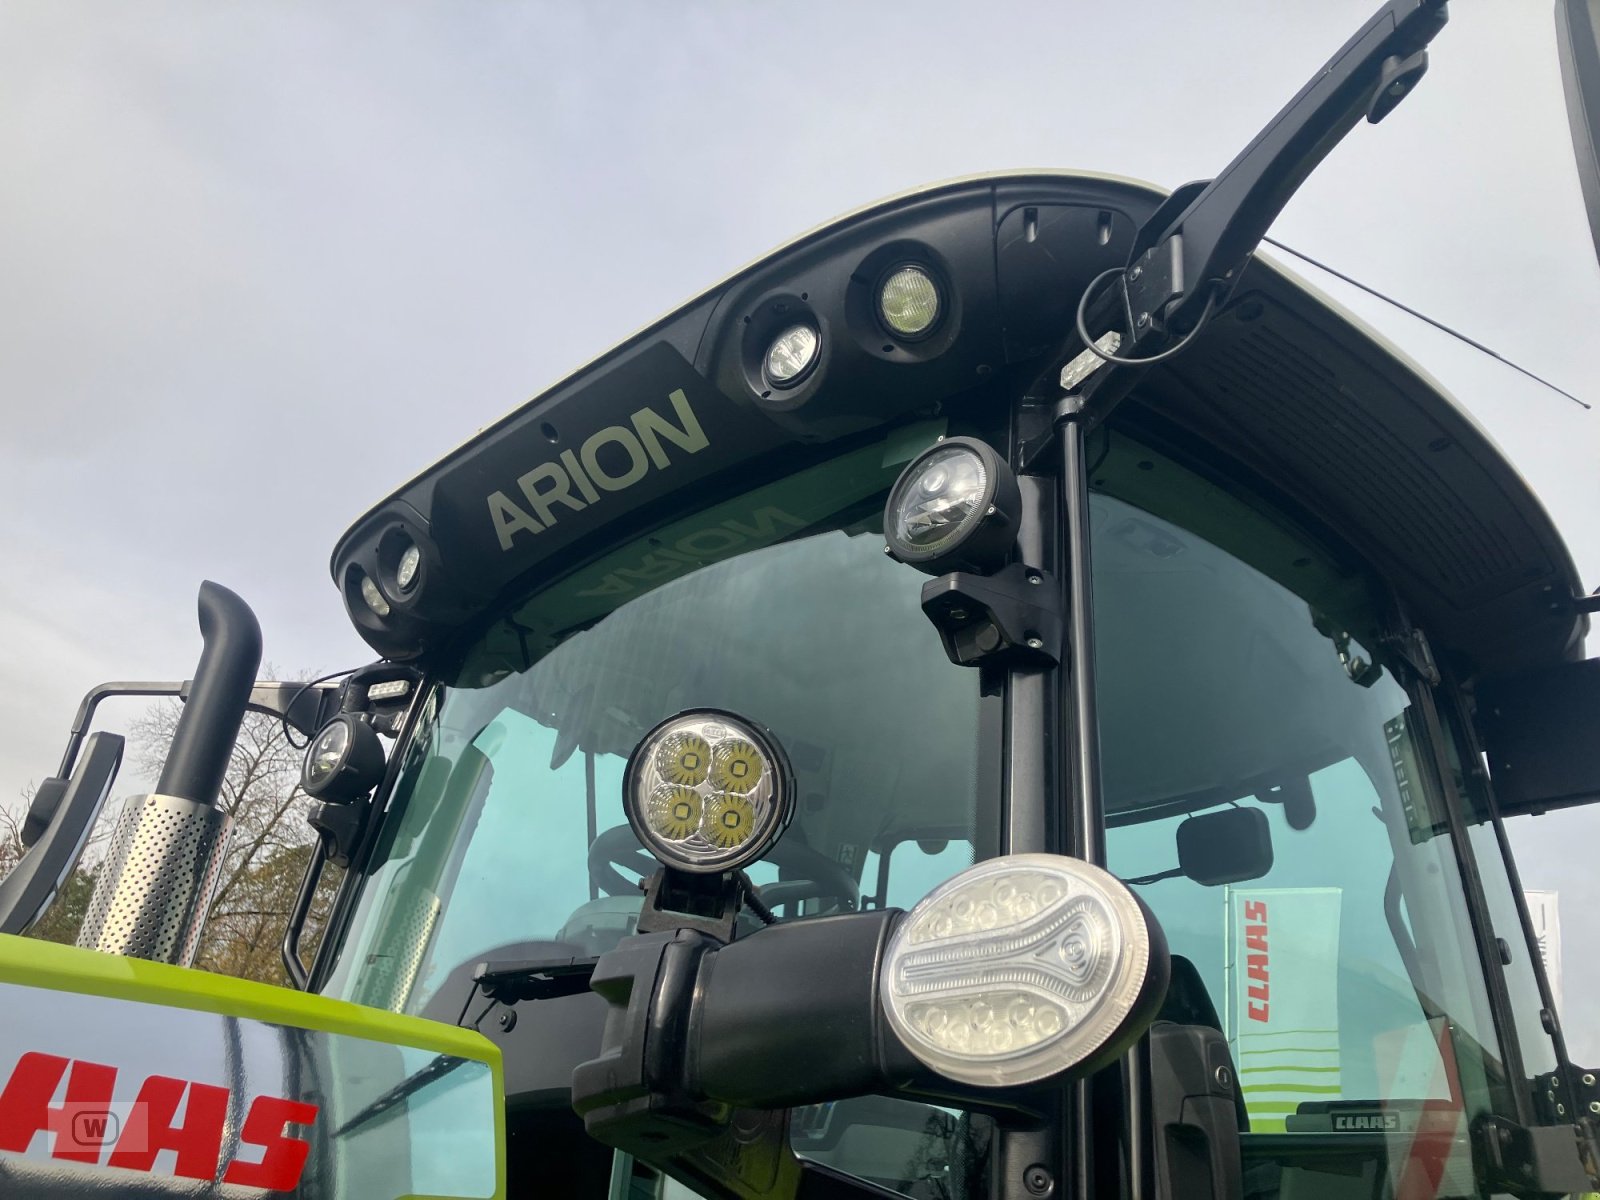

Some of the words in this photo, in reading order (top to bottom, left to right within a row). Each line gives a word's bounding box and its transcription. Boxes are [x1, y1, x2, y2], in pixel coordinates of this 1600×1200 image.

[487, 388, 710, 551] ARION
[1245, 900, 1269, 1022] CLAAS
[0, 1051, 319, 1193] AAS
[1336, 1116, 1396, 1129] CLAAS
